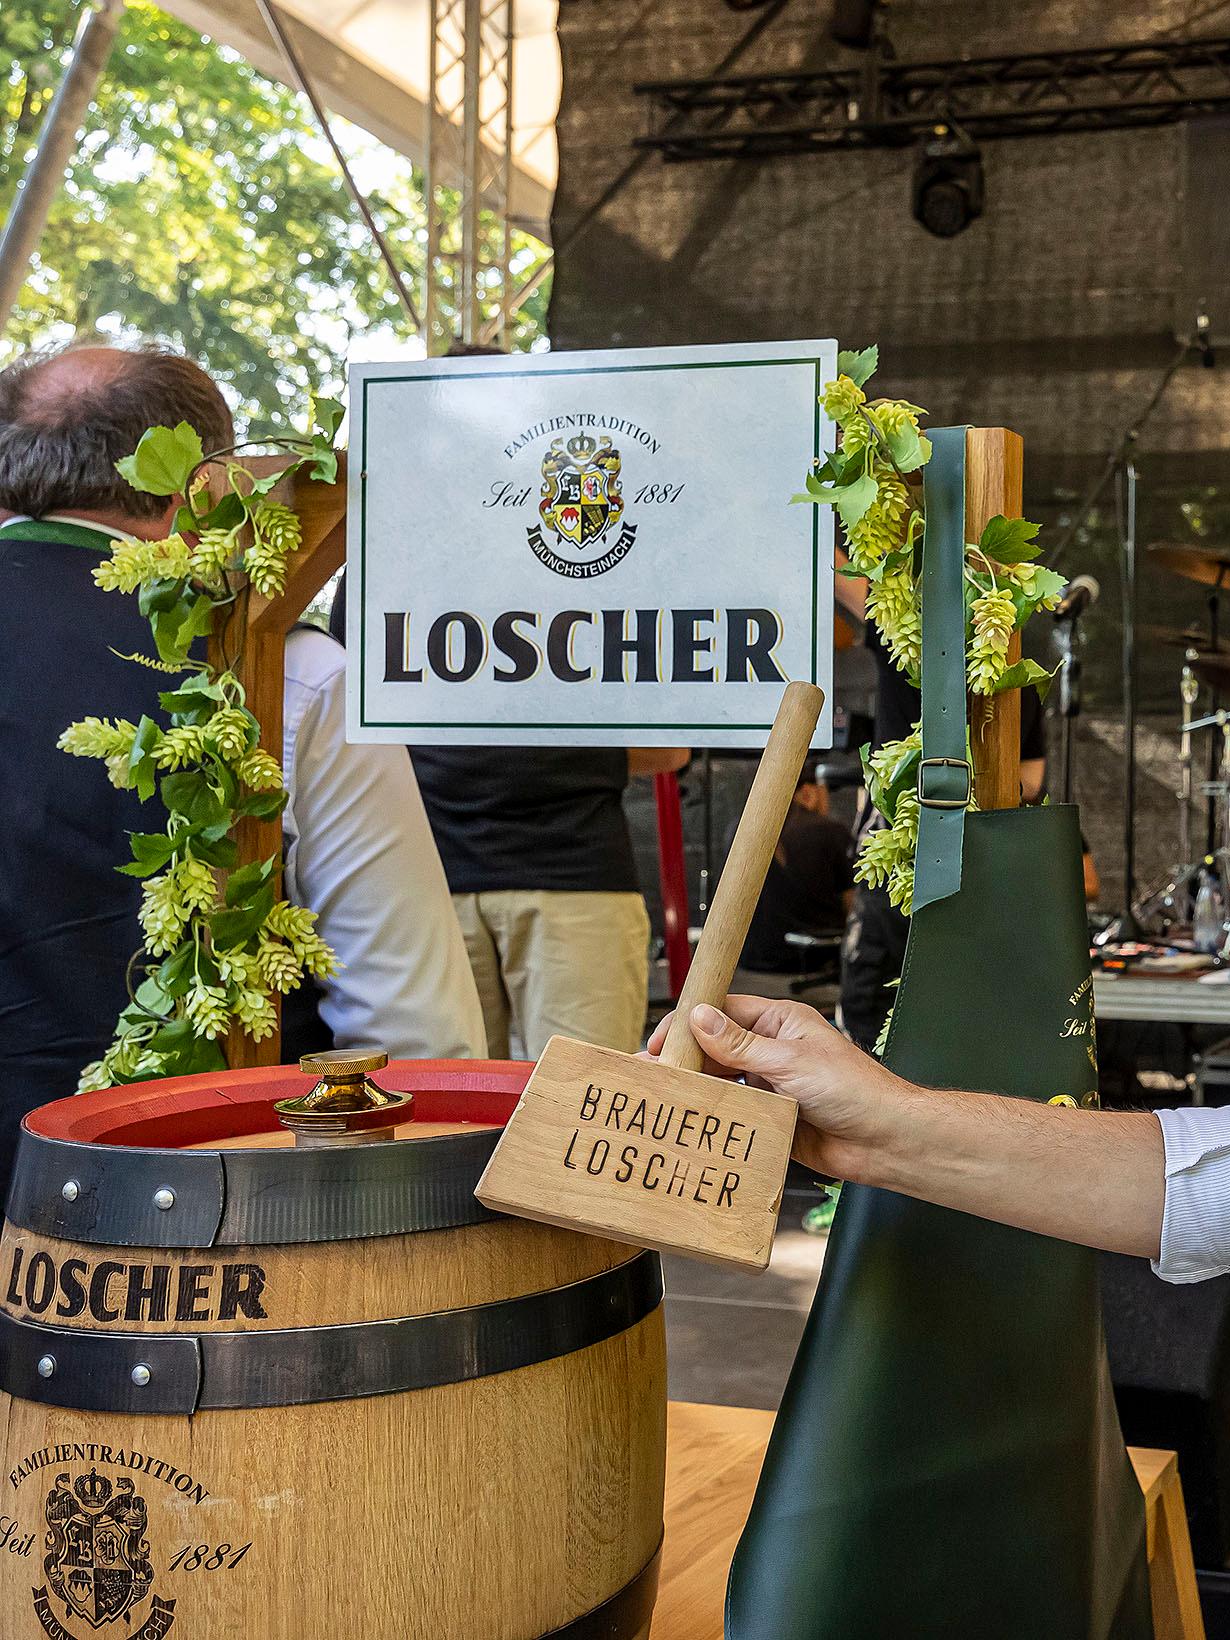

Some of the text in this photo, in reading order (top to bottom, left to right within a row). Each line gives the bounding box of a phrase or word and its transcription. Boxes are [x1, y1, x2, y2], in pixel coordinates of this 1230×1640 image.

[503, 414, 661, 459] FAMILIENTRADITION
[482, 481, 686, 508] Seit 1881
[383, 608, 790, 683] LOSCHER
[1059, 1018, 1088, 1038] Seit
[580, 1083, 757, 1162] BRAUEREI
[563, 1129, 741, 1208] LOSCHER
[6, 1247, 268, 1322] LOSCHER
[8, 1443, 210, 1505] FAMILIENTRADITION
[0, 1516, 253, 1572] Seit 1881
